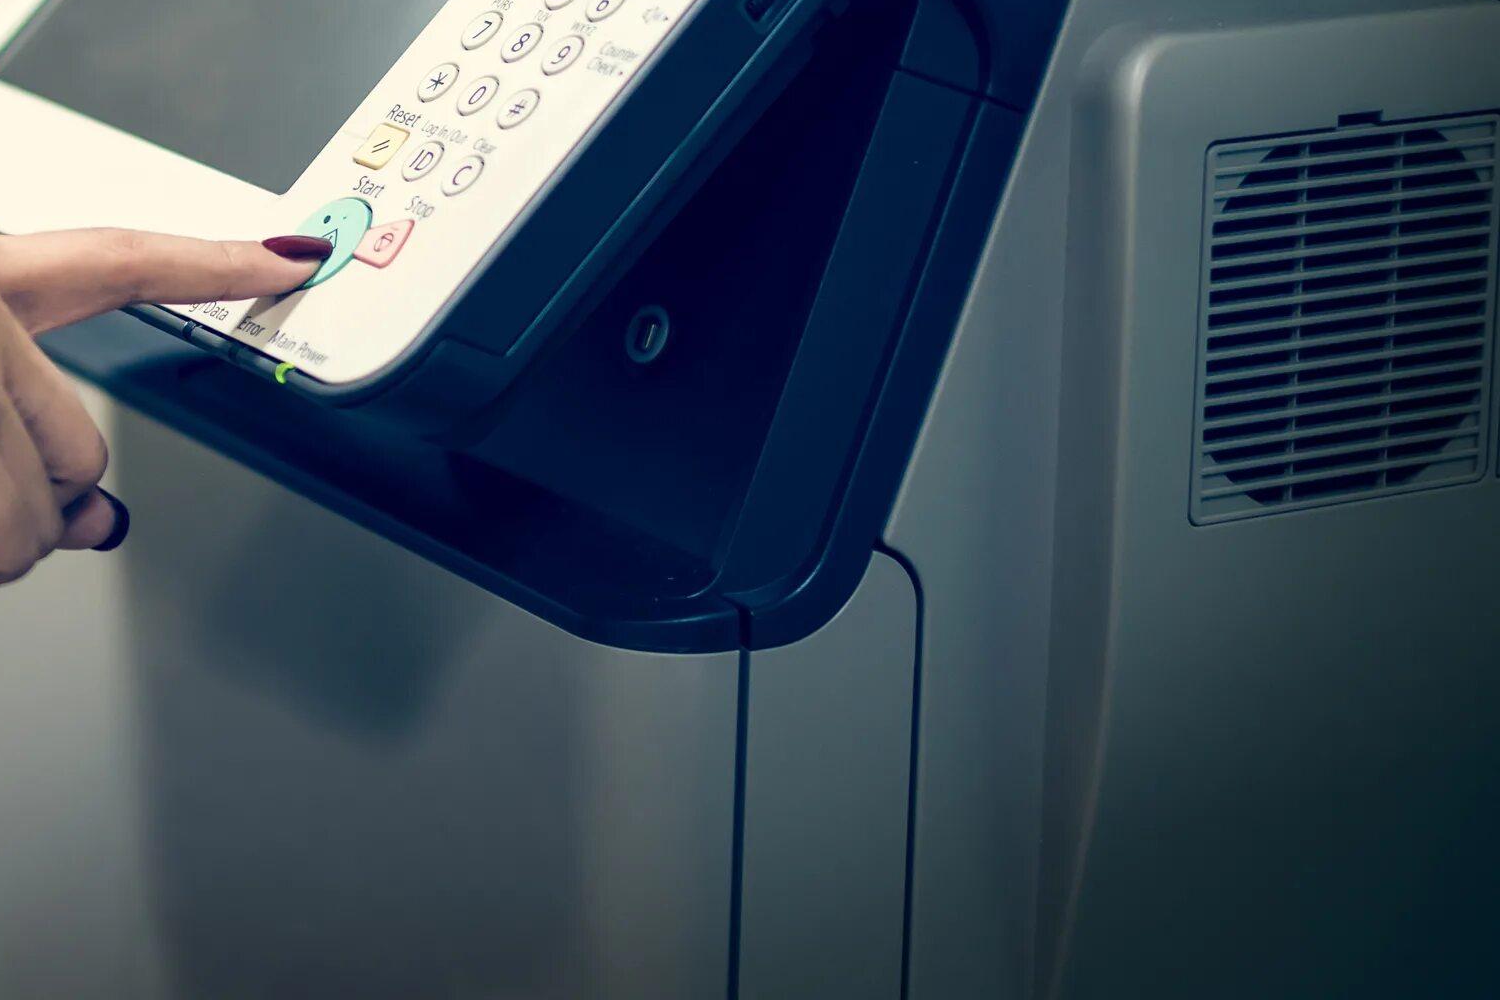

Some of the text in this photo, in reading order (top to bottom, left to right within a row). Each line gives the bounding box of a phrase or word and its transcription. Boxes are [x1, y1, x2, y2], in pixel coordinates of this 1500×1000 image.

[472, 20, 492, 39] 7
[511, 33, 530, 52] 8
[550, 46, 571, 64] 9
[586, 57, 618, 76] Check
[468, 86, 487, 105] 0
[385, 104, 421, 128] Reset
[506, 100, 528, 118] #
[421, 119, 438, 138] Log
[409, 149, 434, 171] ID
[452, 165, 473, 186] C
[352, 175, 386, 199] Start
[404, 195, 435, 220] Stop
[237, 315, 266, 337] Error
[267, 329, 330, 365] Main Power
